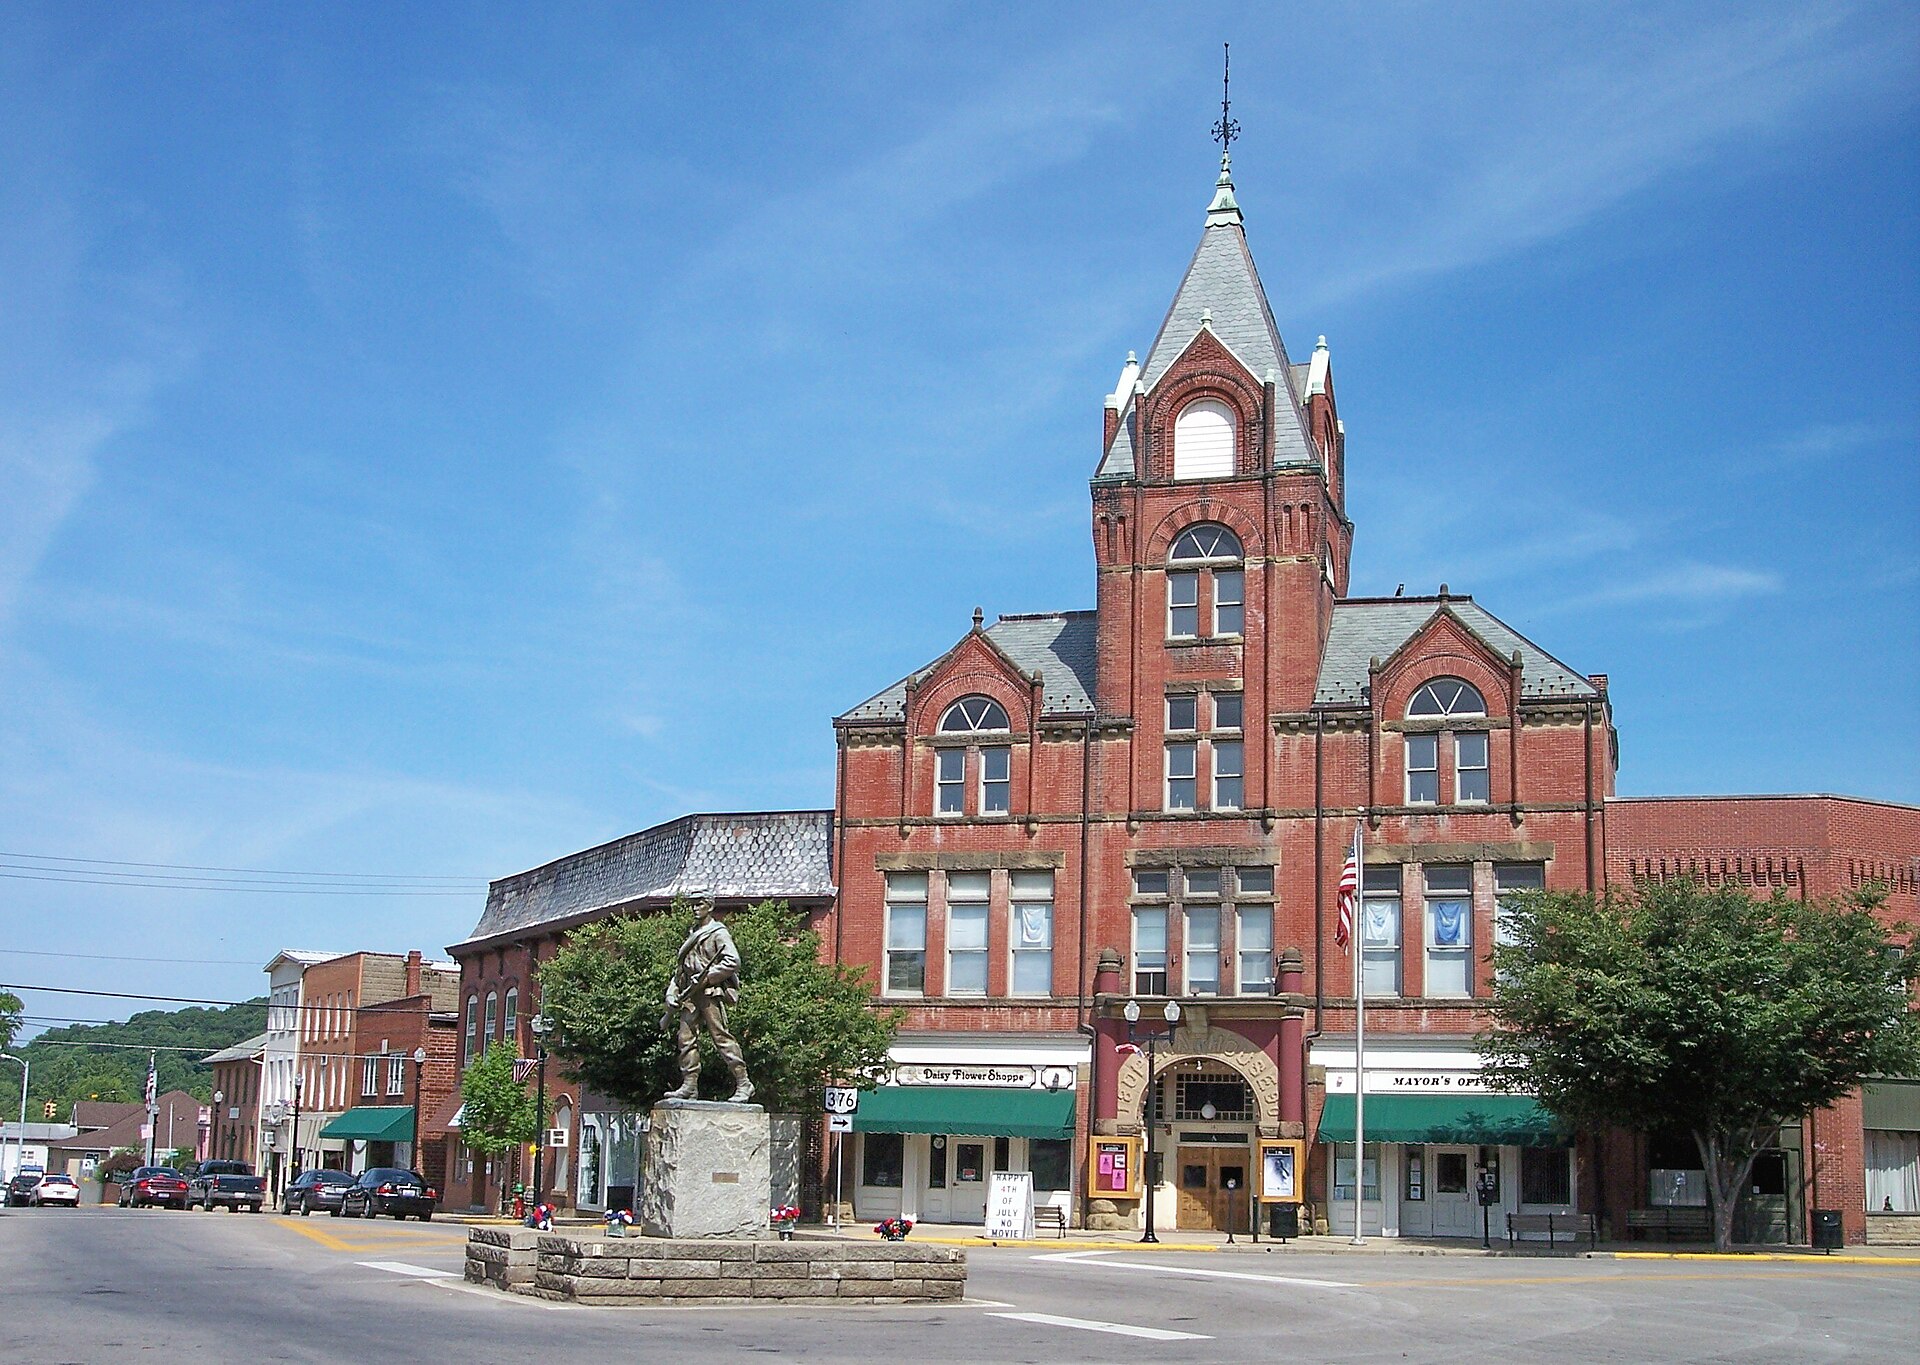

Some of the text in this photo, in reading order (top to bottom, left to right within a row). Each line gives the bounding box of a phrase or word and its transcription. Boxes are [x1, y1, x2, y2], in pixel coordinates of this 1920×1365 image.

[923, 1068, 1024, 1082] Daisy Flower Shoppe
[1393, 1075, 1451, 1086] MAYOR'S
[827, 1092, 854, 1107] 376
[996, 1174, 1025, 1182] HAPPY
[1002, 1197, 1013, 1205] OF
[996, 1209, 1018, 1217] JULY
[1001, 1219, 1012, 1227] NO
[992, 1229, 1019, 1239] MOVIE
